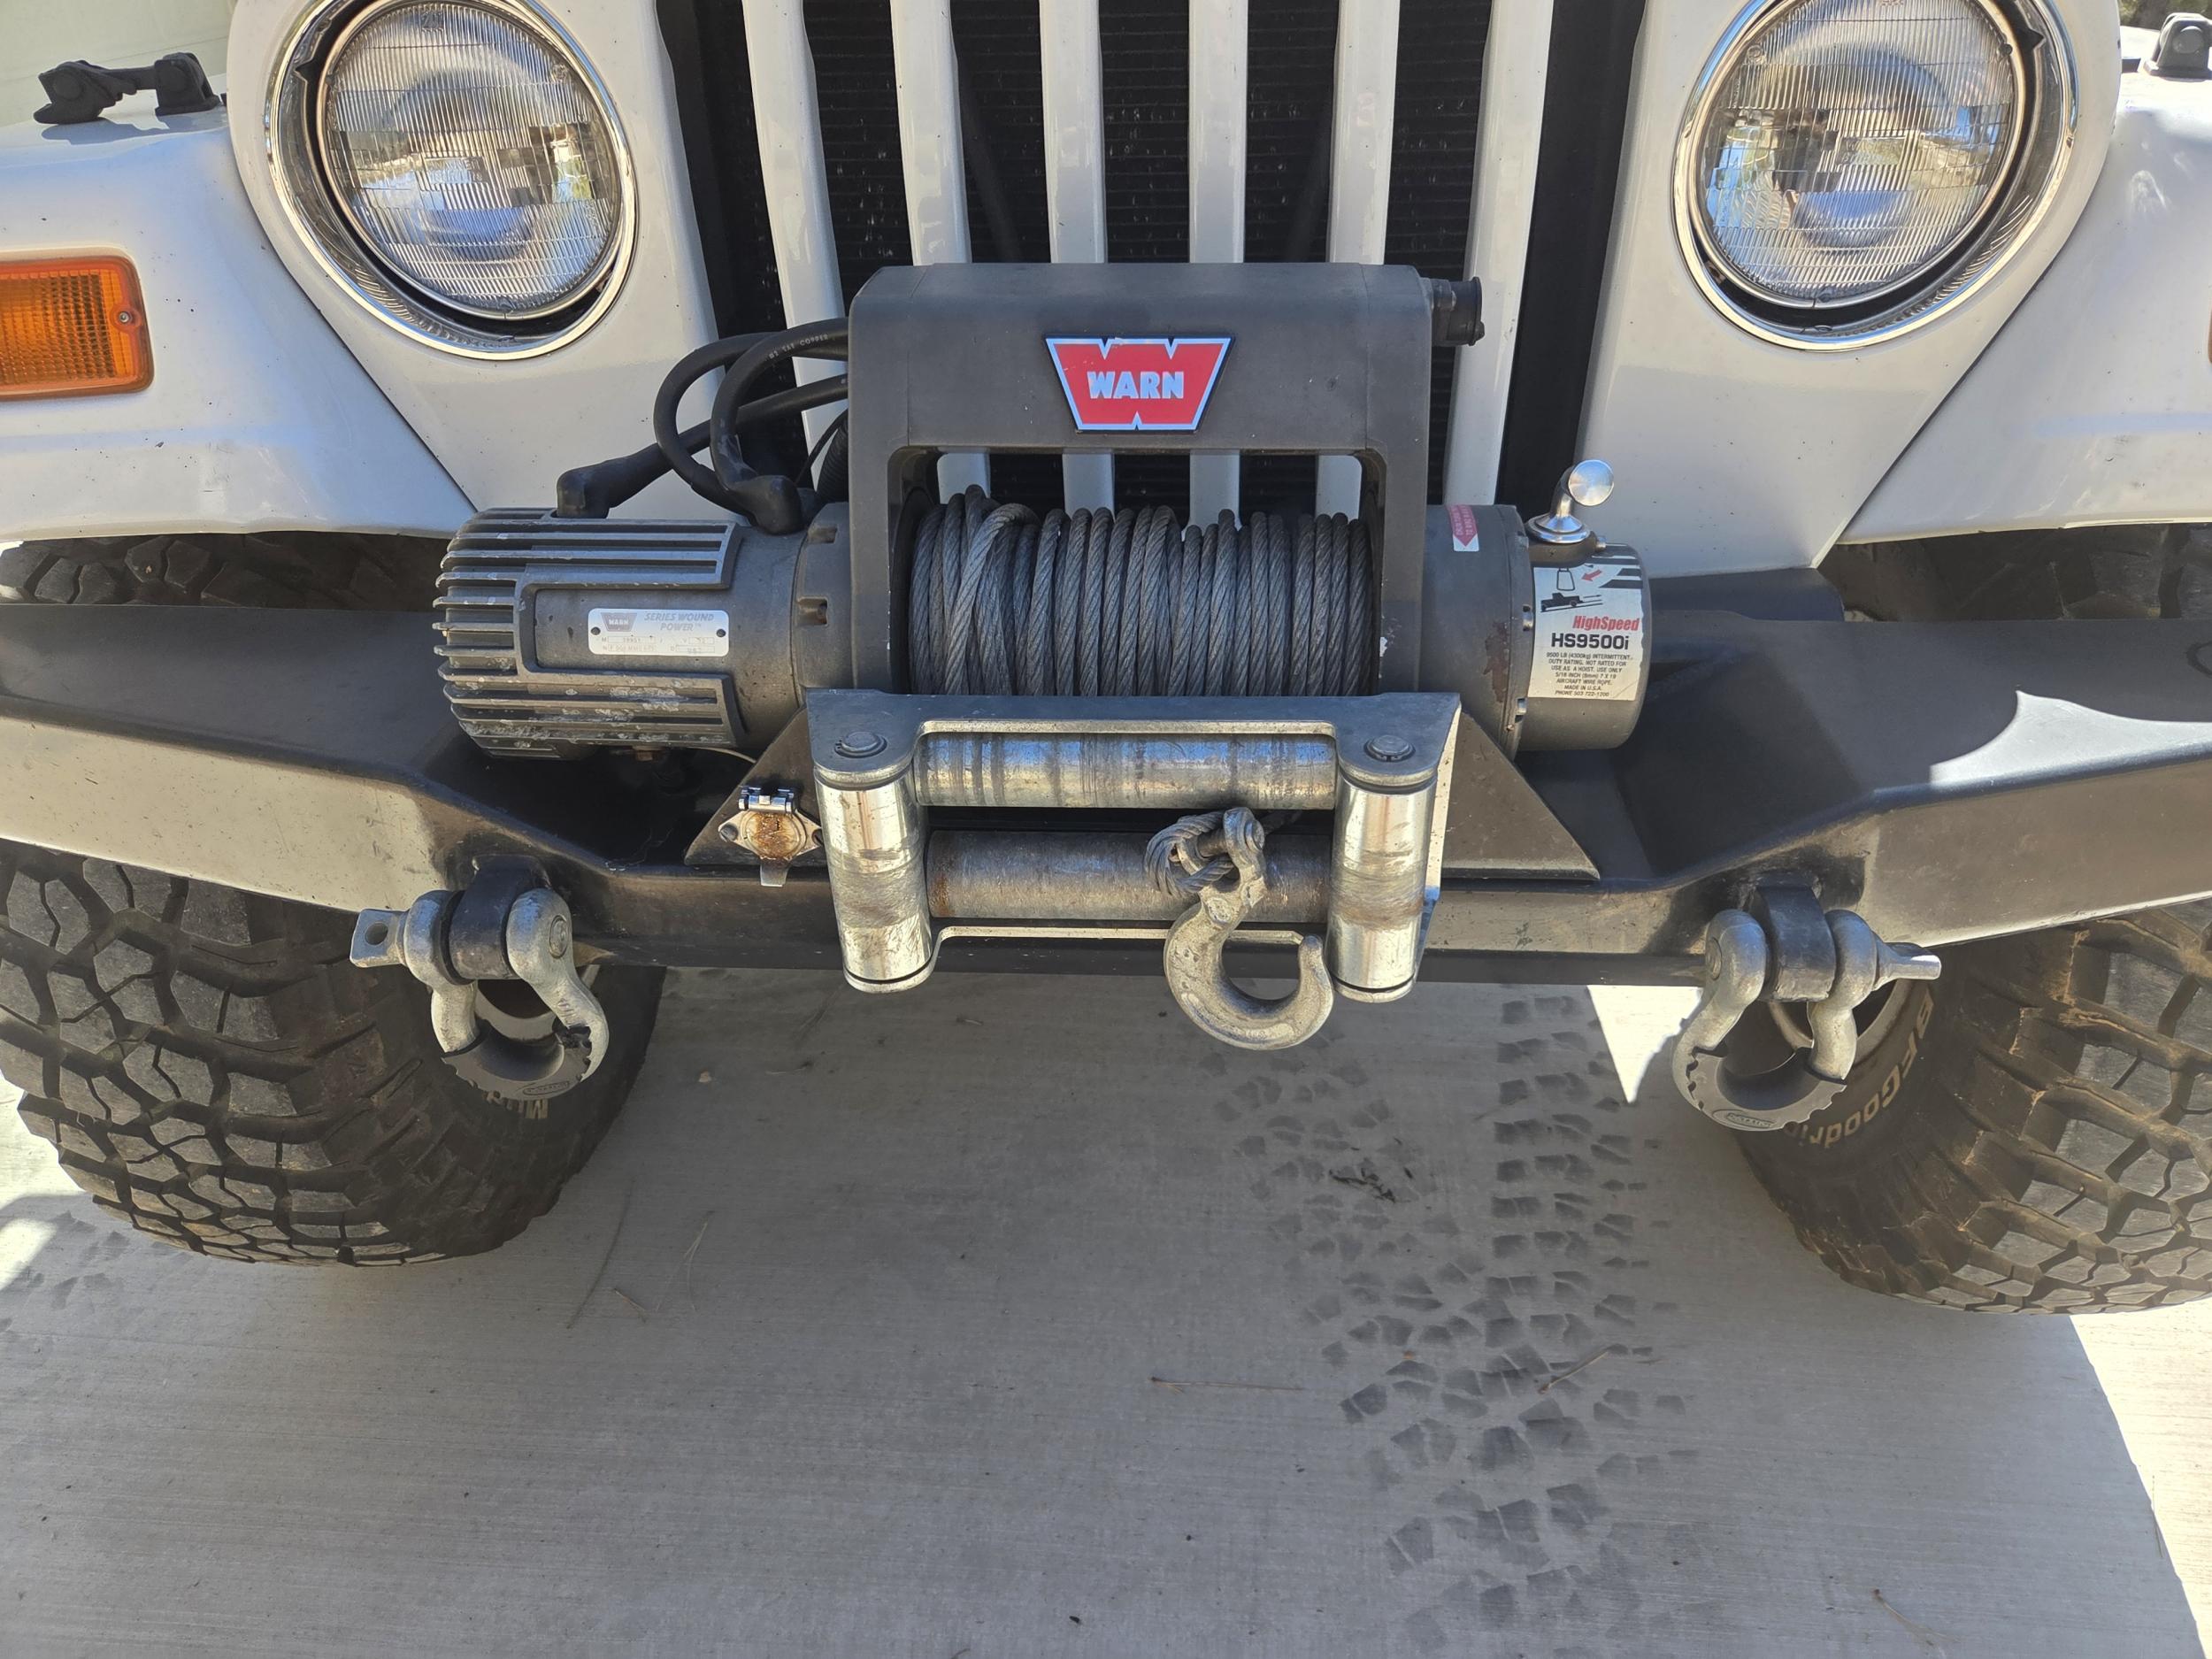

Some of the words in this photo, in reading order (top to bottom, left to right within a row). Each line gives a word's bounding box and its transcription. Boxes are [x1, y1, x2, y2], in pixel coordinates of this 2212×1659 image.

[1087, 371, 1185, 399] WARN
[644, 612, 677, 621] SERIES
[1572, 615, 1640, 632] HighSpeed
[1551, 633, 1630, 650] HS9500i
